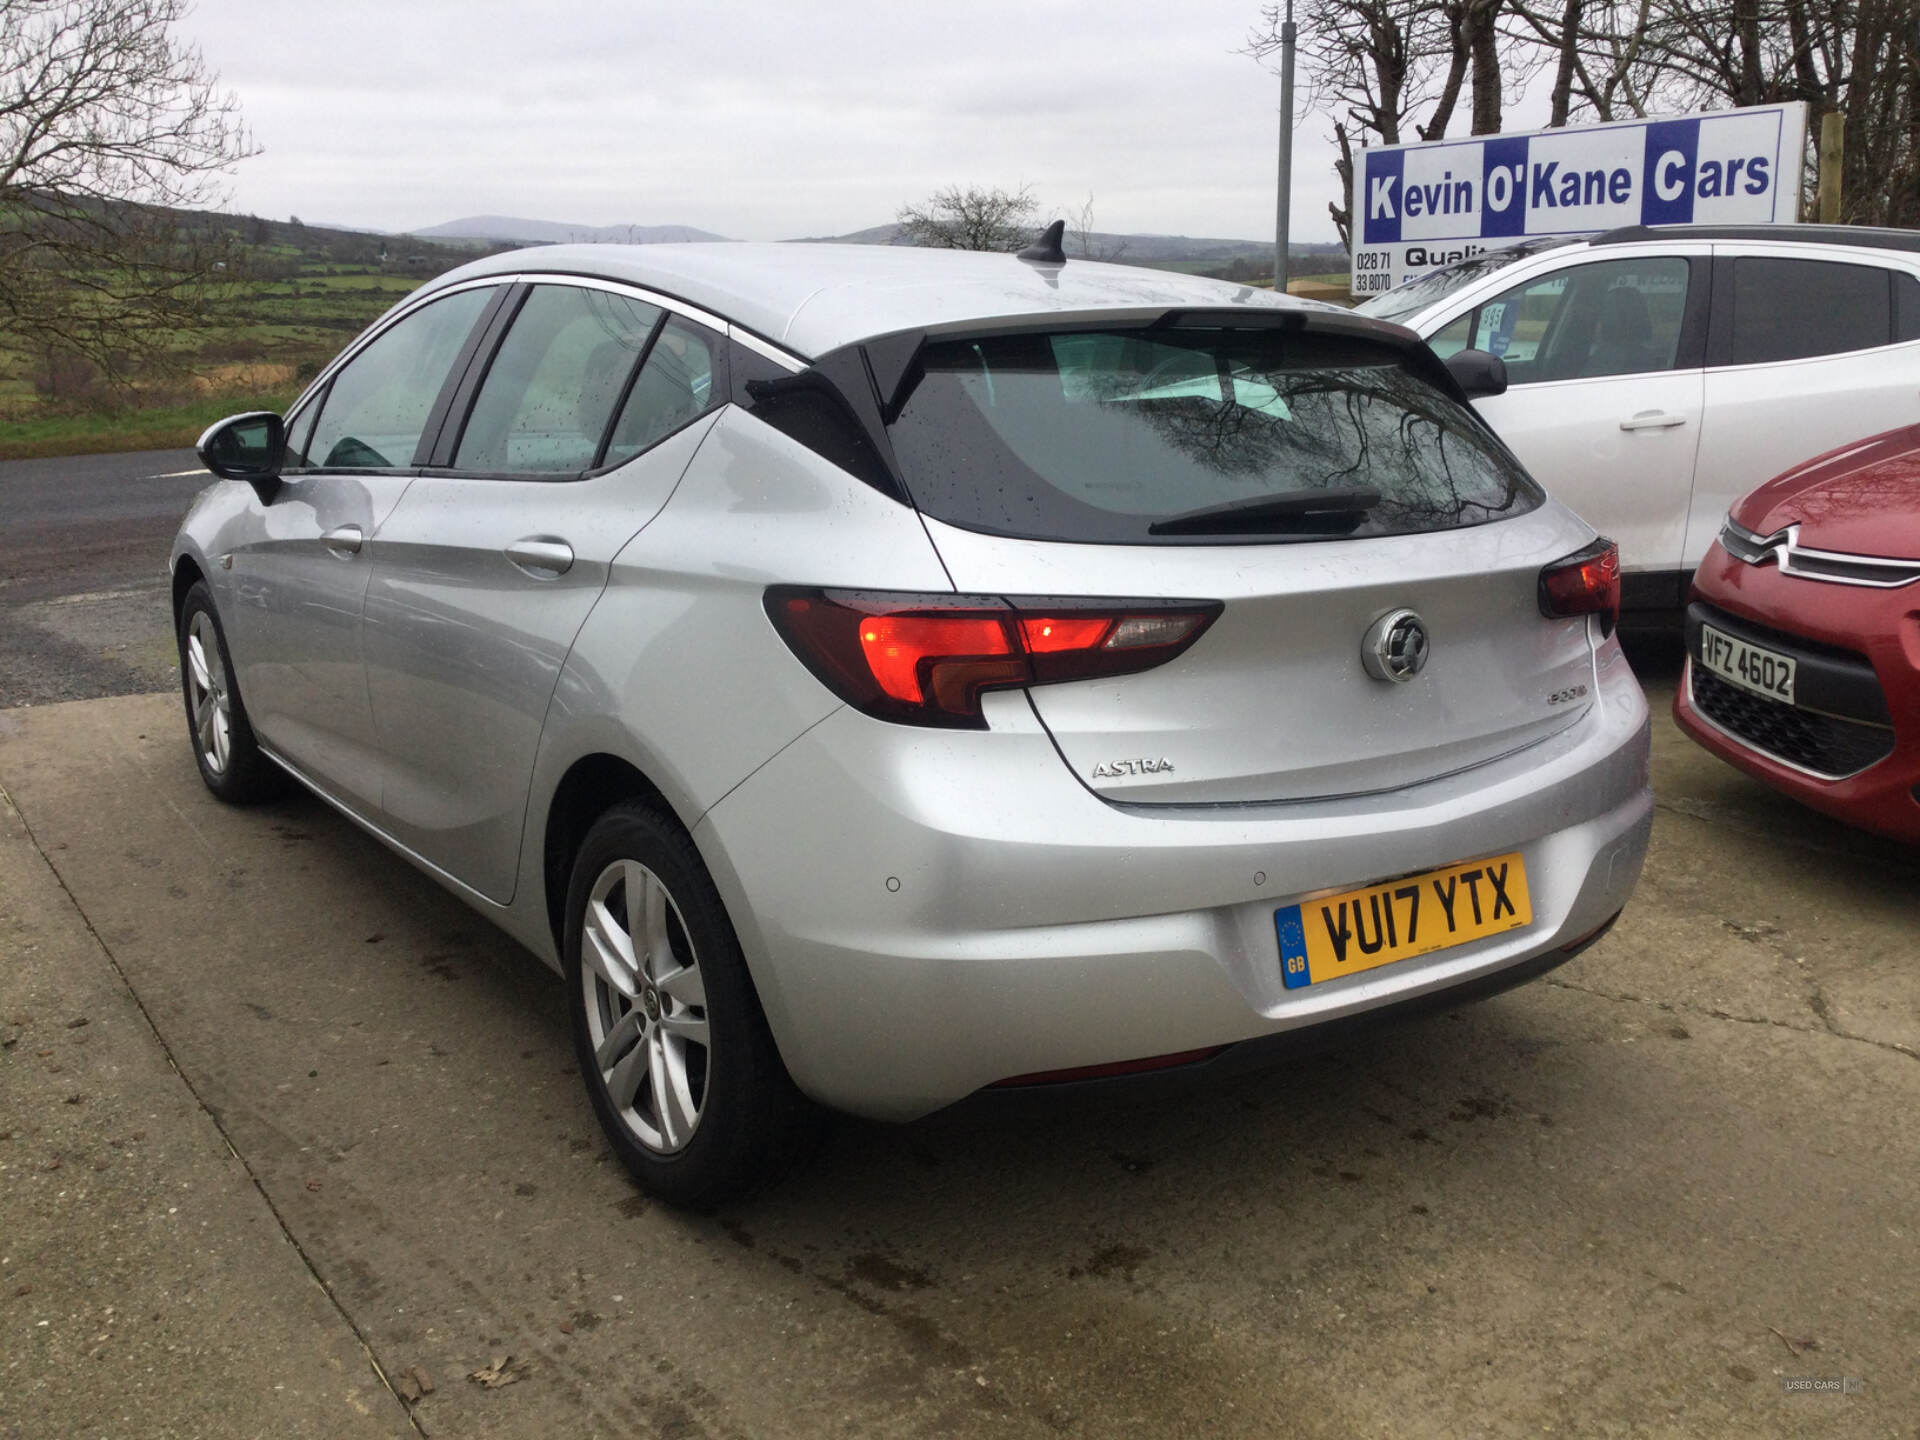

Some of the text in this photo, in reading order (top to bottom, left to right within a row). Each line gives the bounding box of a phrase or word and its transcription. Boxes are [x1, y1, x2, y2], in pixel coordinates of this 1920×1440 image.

[1371, 150, 1770, 221] Kevin O'Kane Cars
[1357, 252, 1391, 270] 028 71
[1405, 245, 1486, 267] Quali
[1356, 274, 1367, 292] 33
[1368, 274, 1391, 292] 8070
[1705, 631, 1790, 697] VFZ 4602
[1092, 756, 1175, 779] ASTRA
[1321, 863, 1516, 962] VU17 YTX
[1287, 955, 1306, 974] GB
